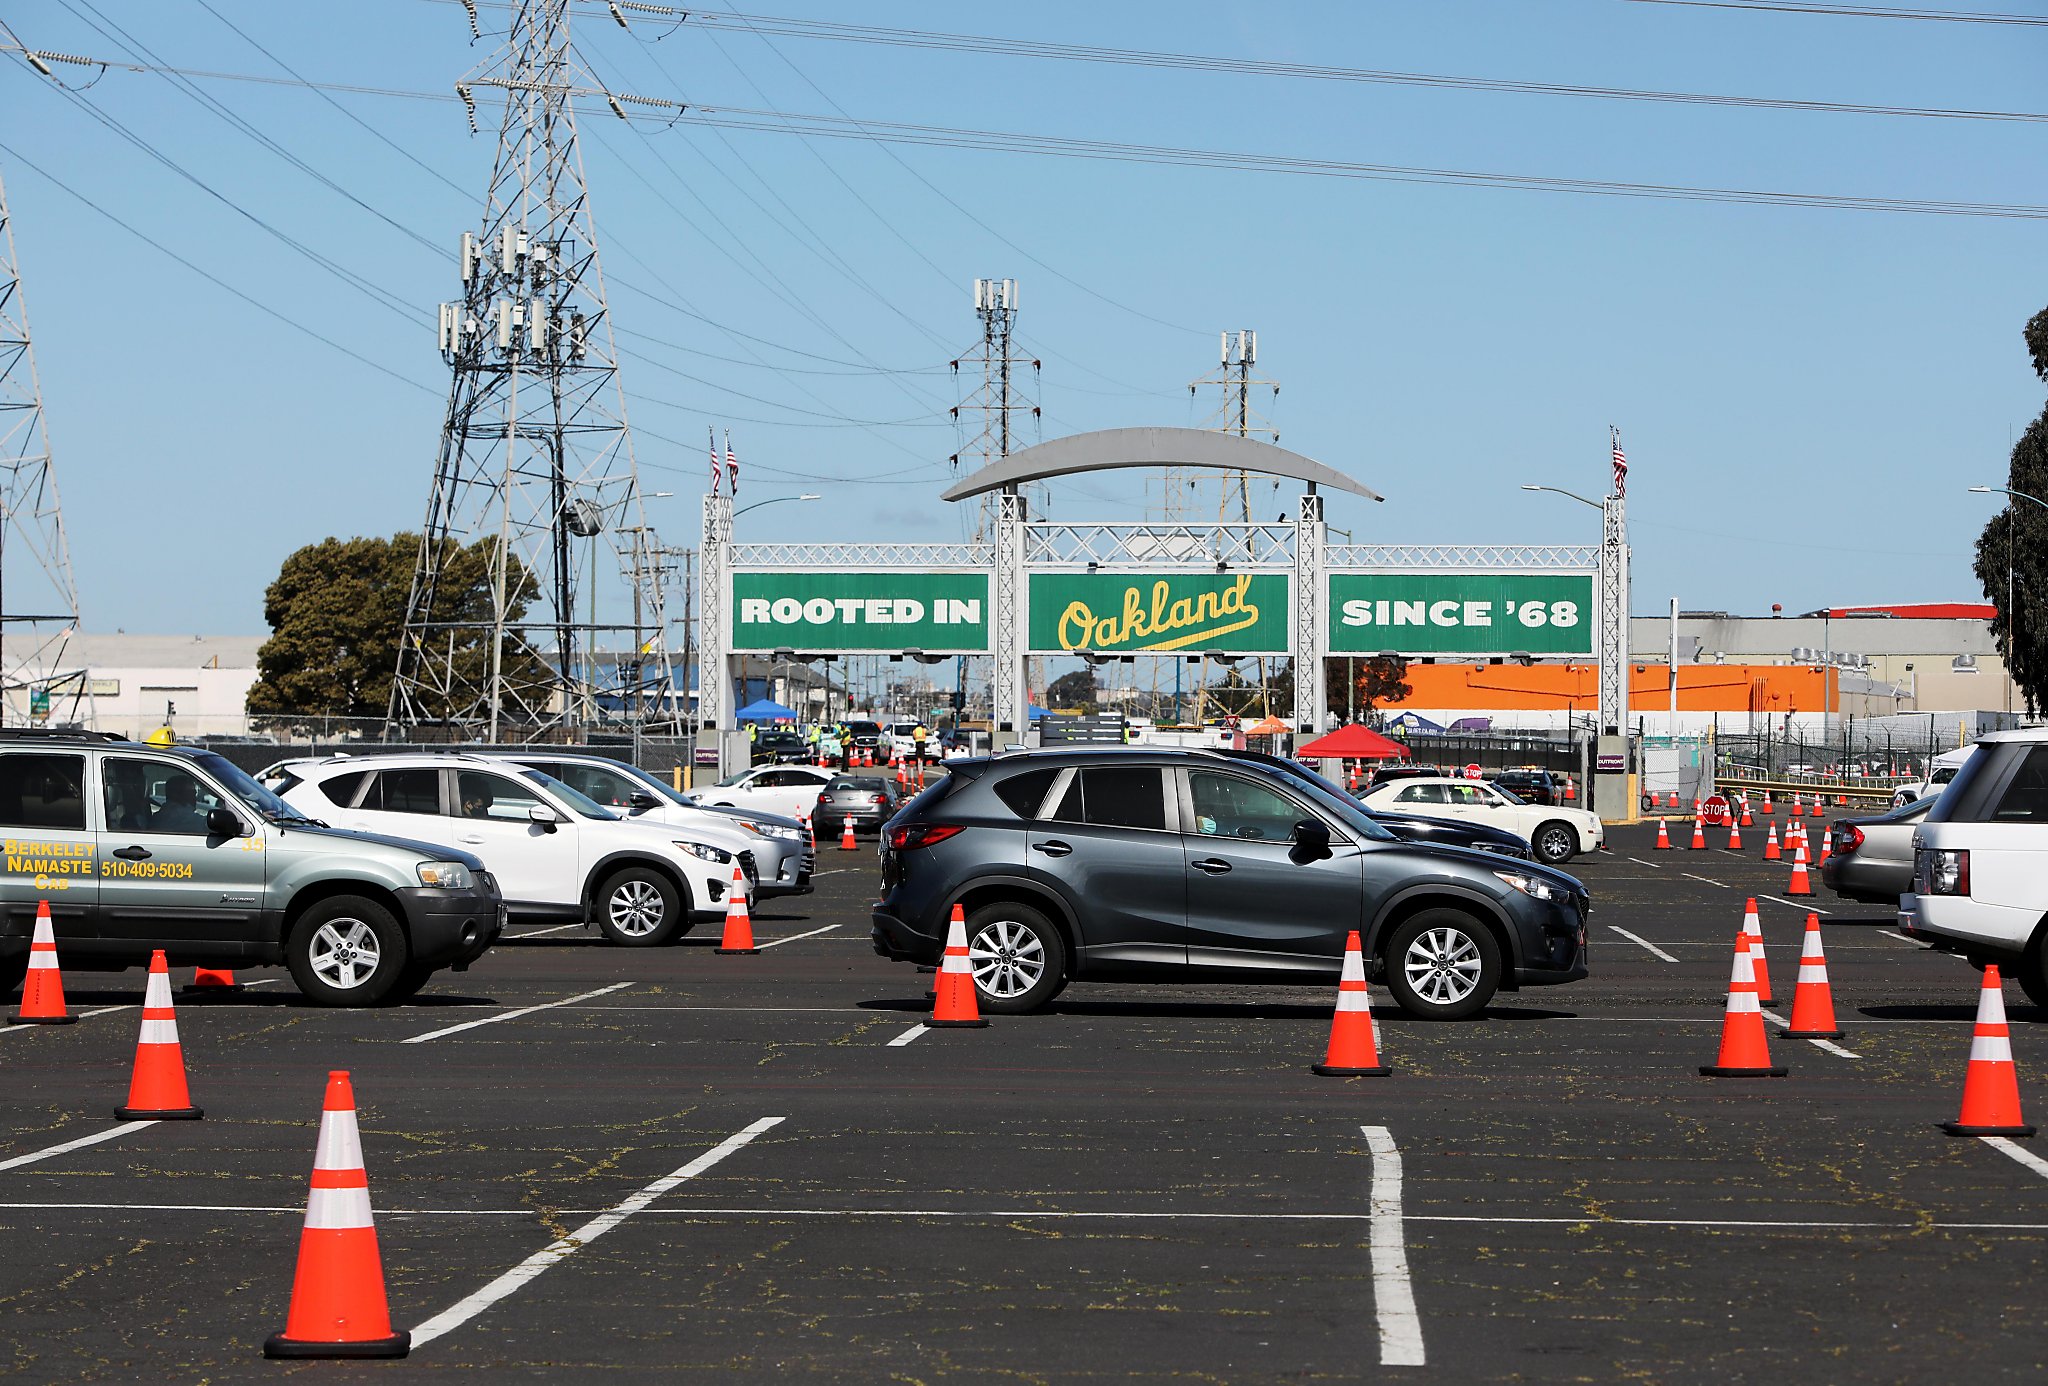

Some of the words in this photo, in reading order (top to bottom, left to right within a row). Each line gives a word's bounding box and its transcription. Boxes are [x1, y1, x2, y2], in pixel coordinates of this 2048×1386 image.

[741, 597, 925, 625] ROOTED
[933, 599, 981, 625] IN
[1058, 575, 1259, 651] Oakland
[1341, 599, 1492, 627] SINCE
[1506, 600, 1579, 628] '68
[1465, 769, 1483, 778] STOP
[1703, 804, 1725, 816] STOP
[4, 839, 96, 858] BERKELEY
[241, 838, 265, 852] 35
[7, 856, 92, 875] NAMASTE
[34, 874, 70, 891] CAB
